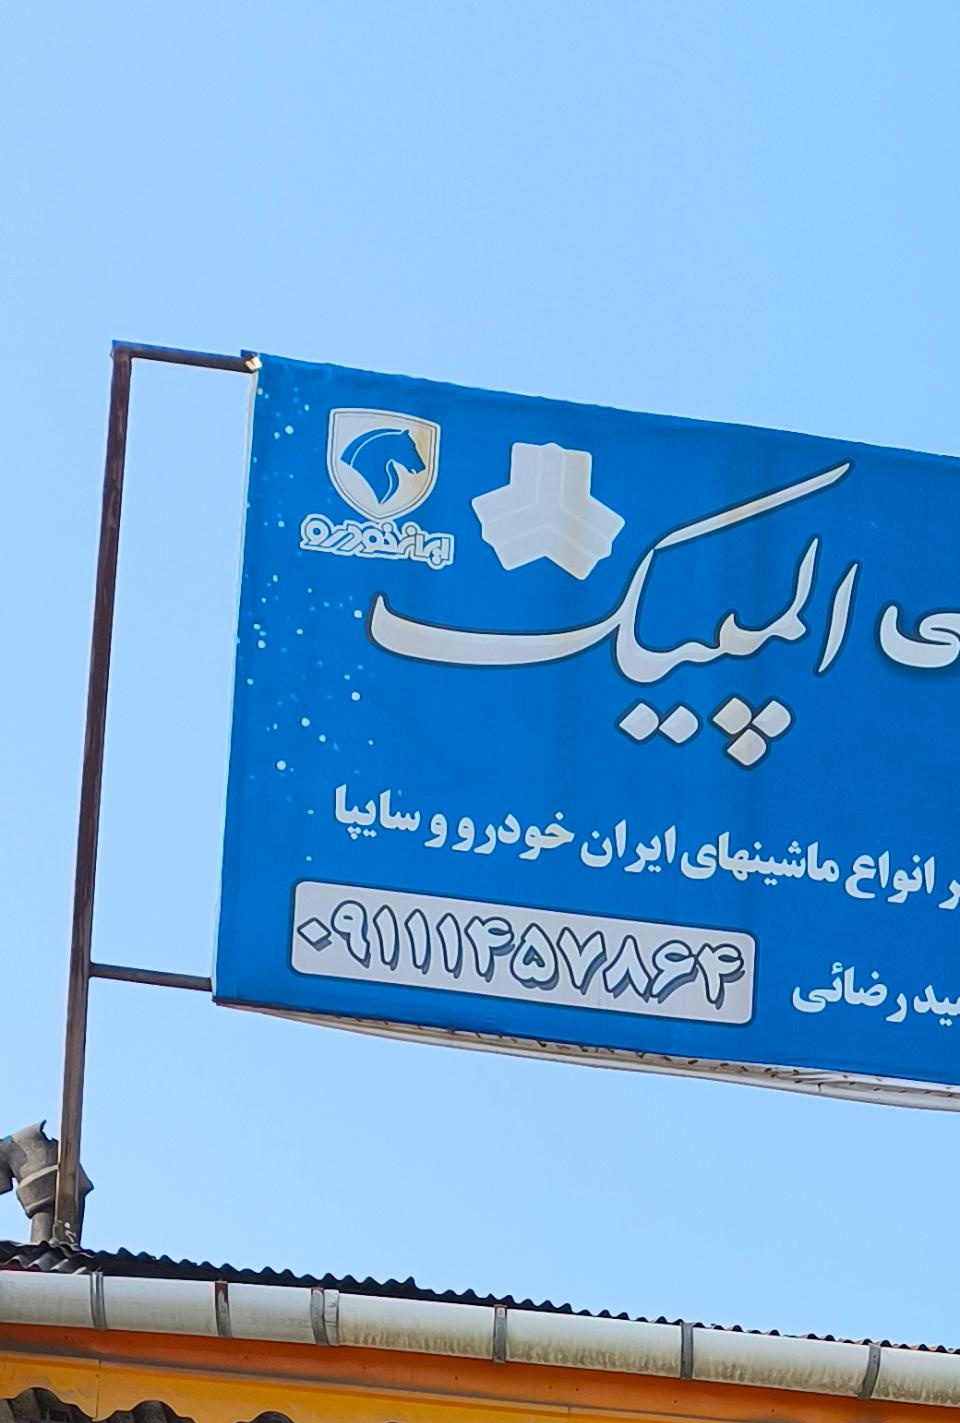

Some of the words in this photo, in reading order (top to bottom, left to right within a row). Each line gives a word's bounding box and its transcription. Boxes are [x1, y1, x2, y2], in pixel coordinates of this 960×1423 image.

[371, 462, 857, 766] المپیک
[334, 784, 420, 839] سایپا
[424, 813, 448, 848] و
[452, 811, 574, 860] خودرو
[580, 820, 675, 874] ایران
[680, 832, 840, 886] ماشینهای
[845, 854, 934, 904] انواع
[297, 900, 745, 1009] ۰۹۱۱۱۴۵۷۸۶۴
